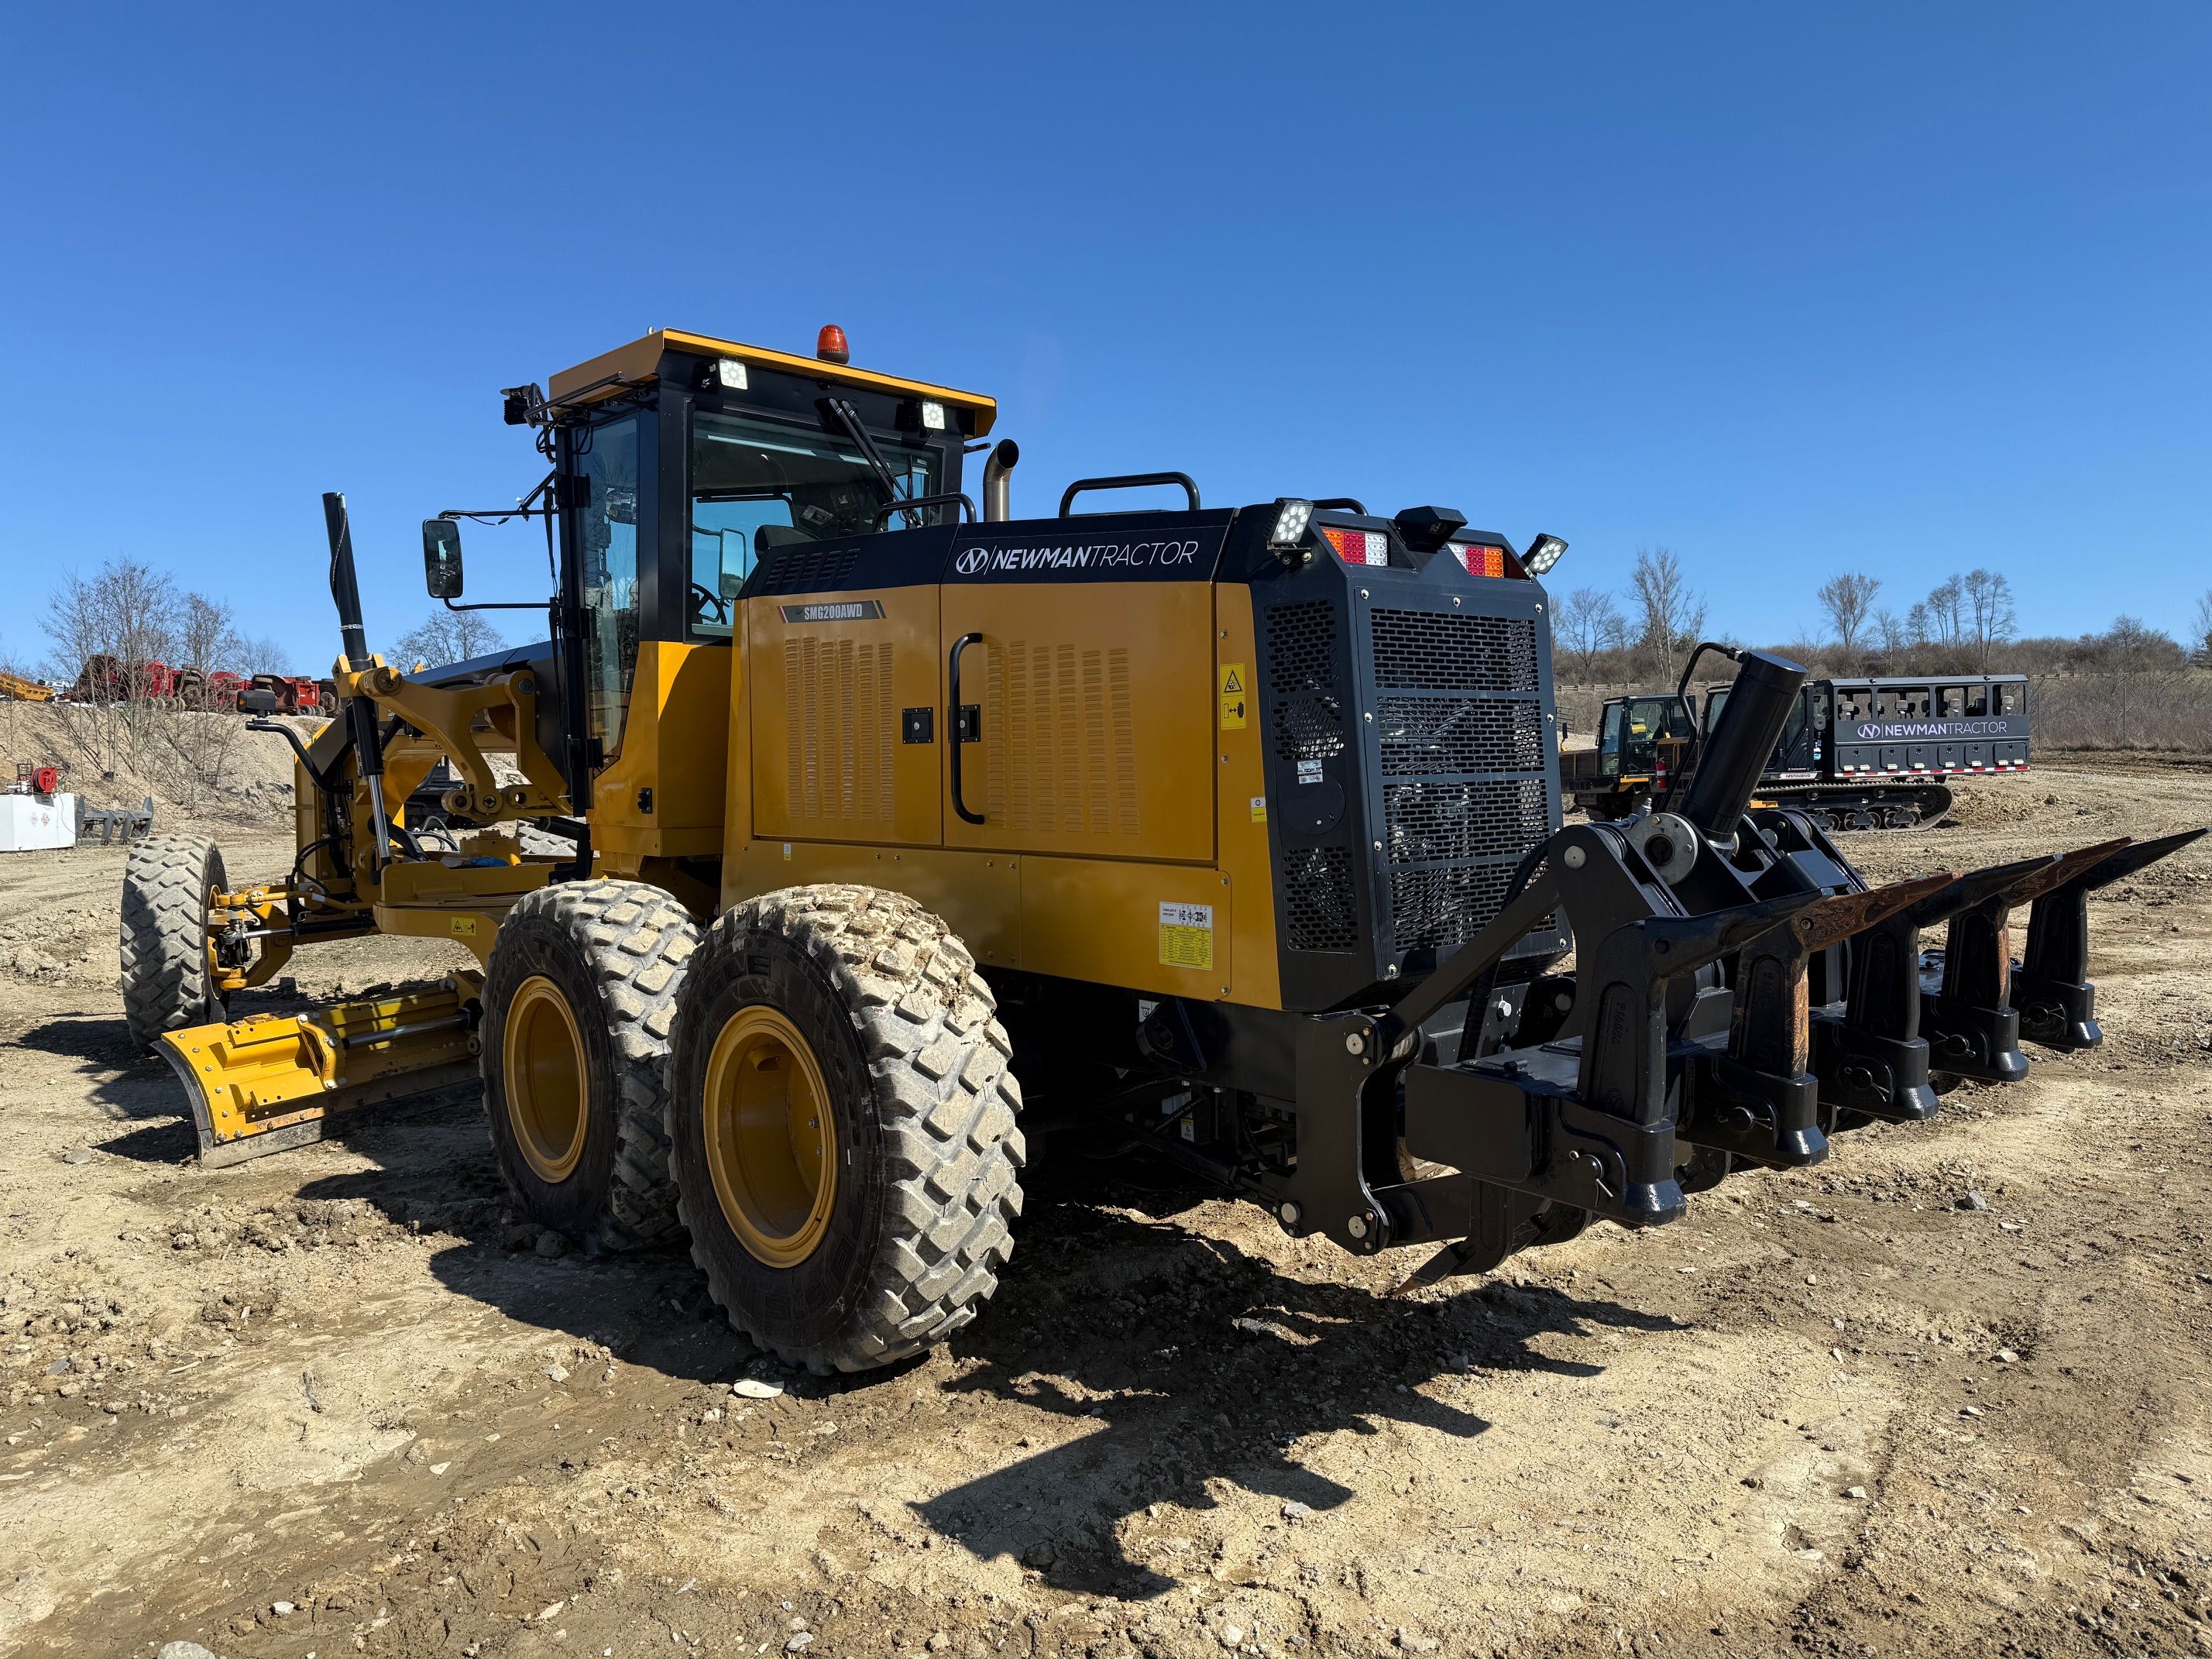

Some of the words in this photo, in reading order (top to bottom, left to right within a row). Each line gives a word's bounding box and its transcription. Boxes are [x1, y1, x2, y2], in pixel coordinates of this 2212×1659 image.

[991, 541, 1199, 570] NEWMANTRACTOR
[804, 603, 863, 620] SMG200AWD
[1884, 721, 2008, 737] NEWMANTRACTOR
